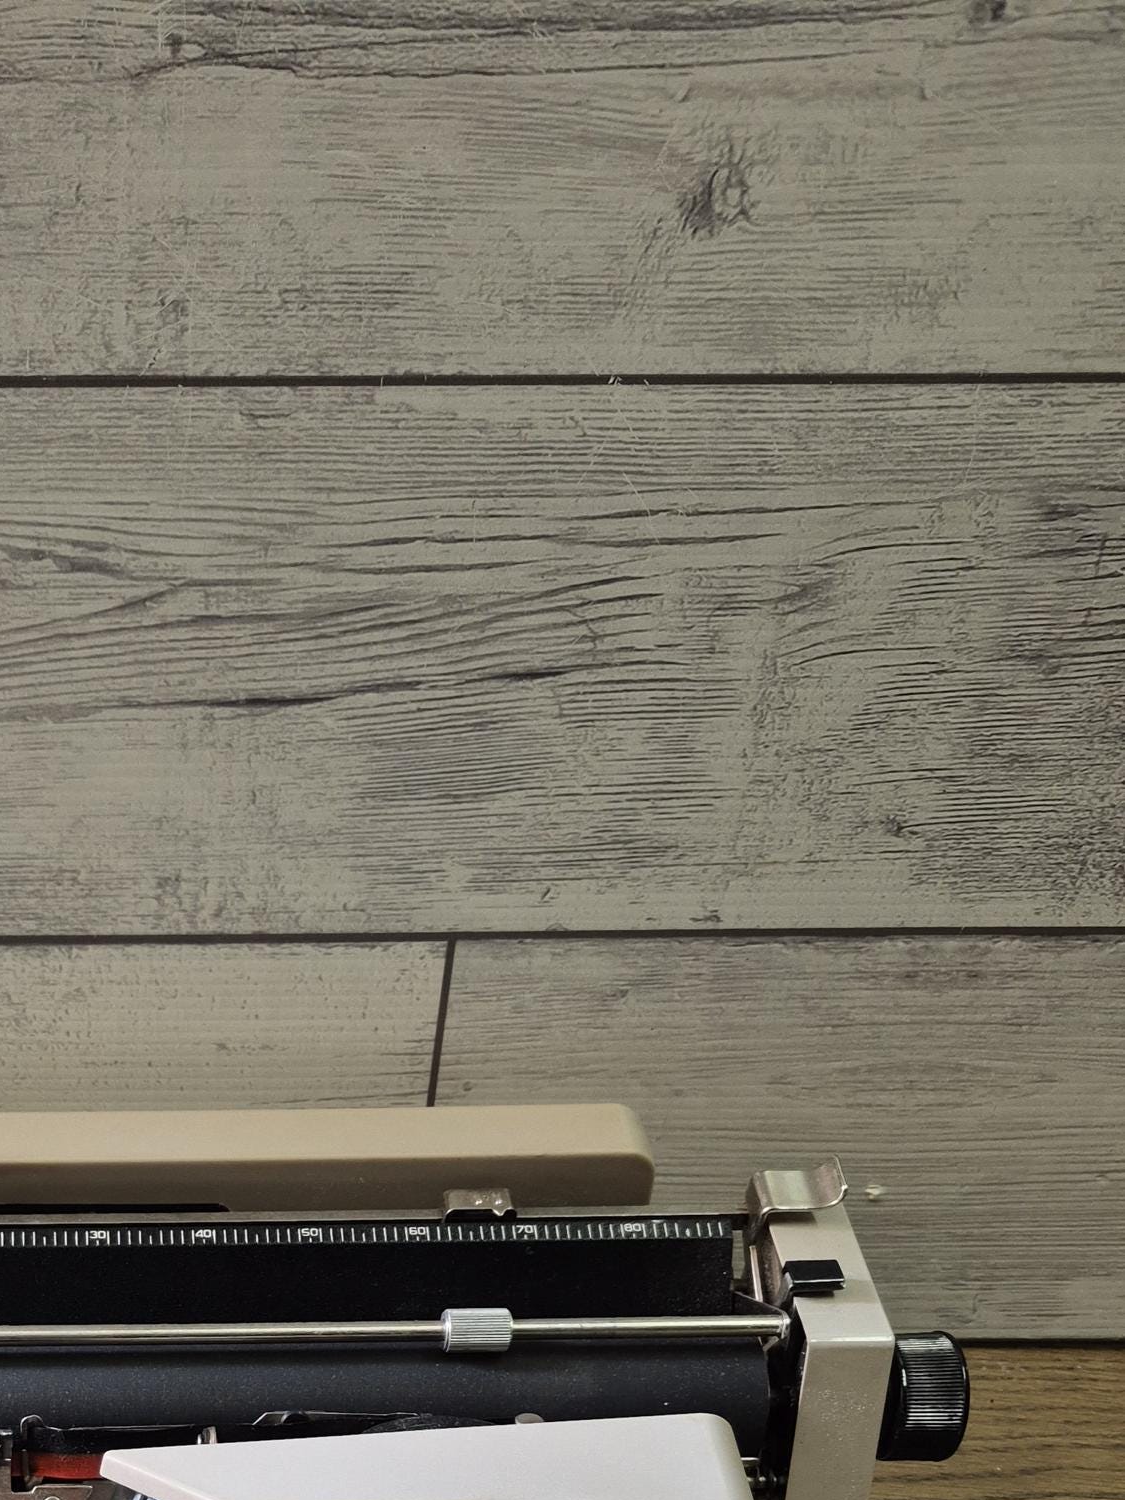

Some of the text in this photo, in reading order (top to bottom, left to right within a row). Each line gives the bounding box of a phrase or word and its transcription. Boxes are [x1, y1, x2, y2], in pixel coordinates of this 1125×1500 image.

[89, 1230, 107, 1239] 30
[195, 1229, 212, 1238] 40
[301, 1227, 319, 1237] 50
[409, 1226, 426, 1236] 60
[516, 1224, 534, 1234] 70
[625, 1223, 642, 1232] 80
